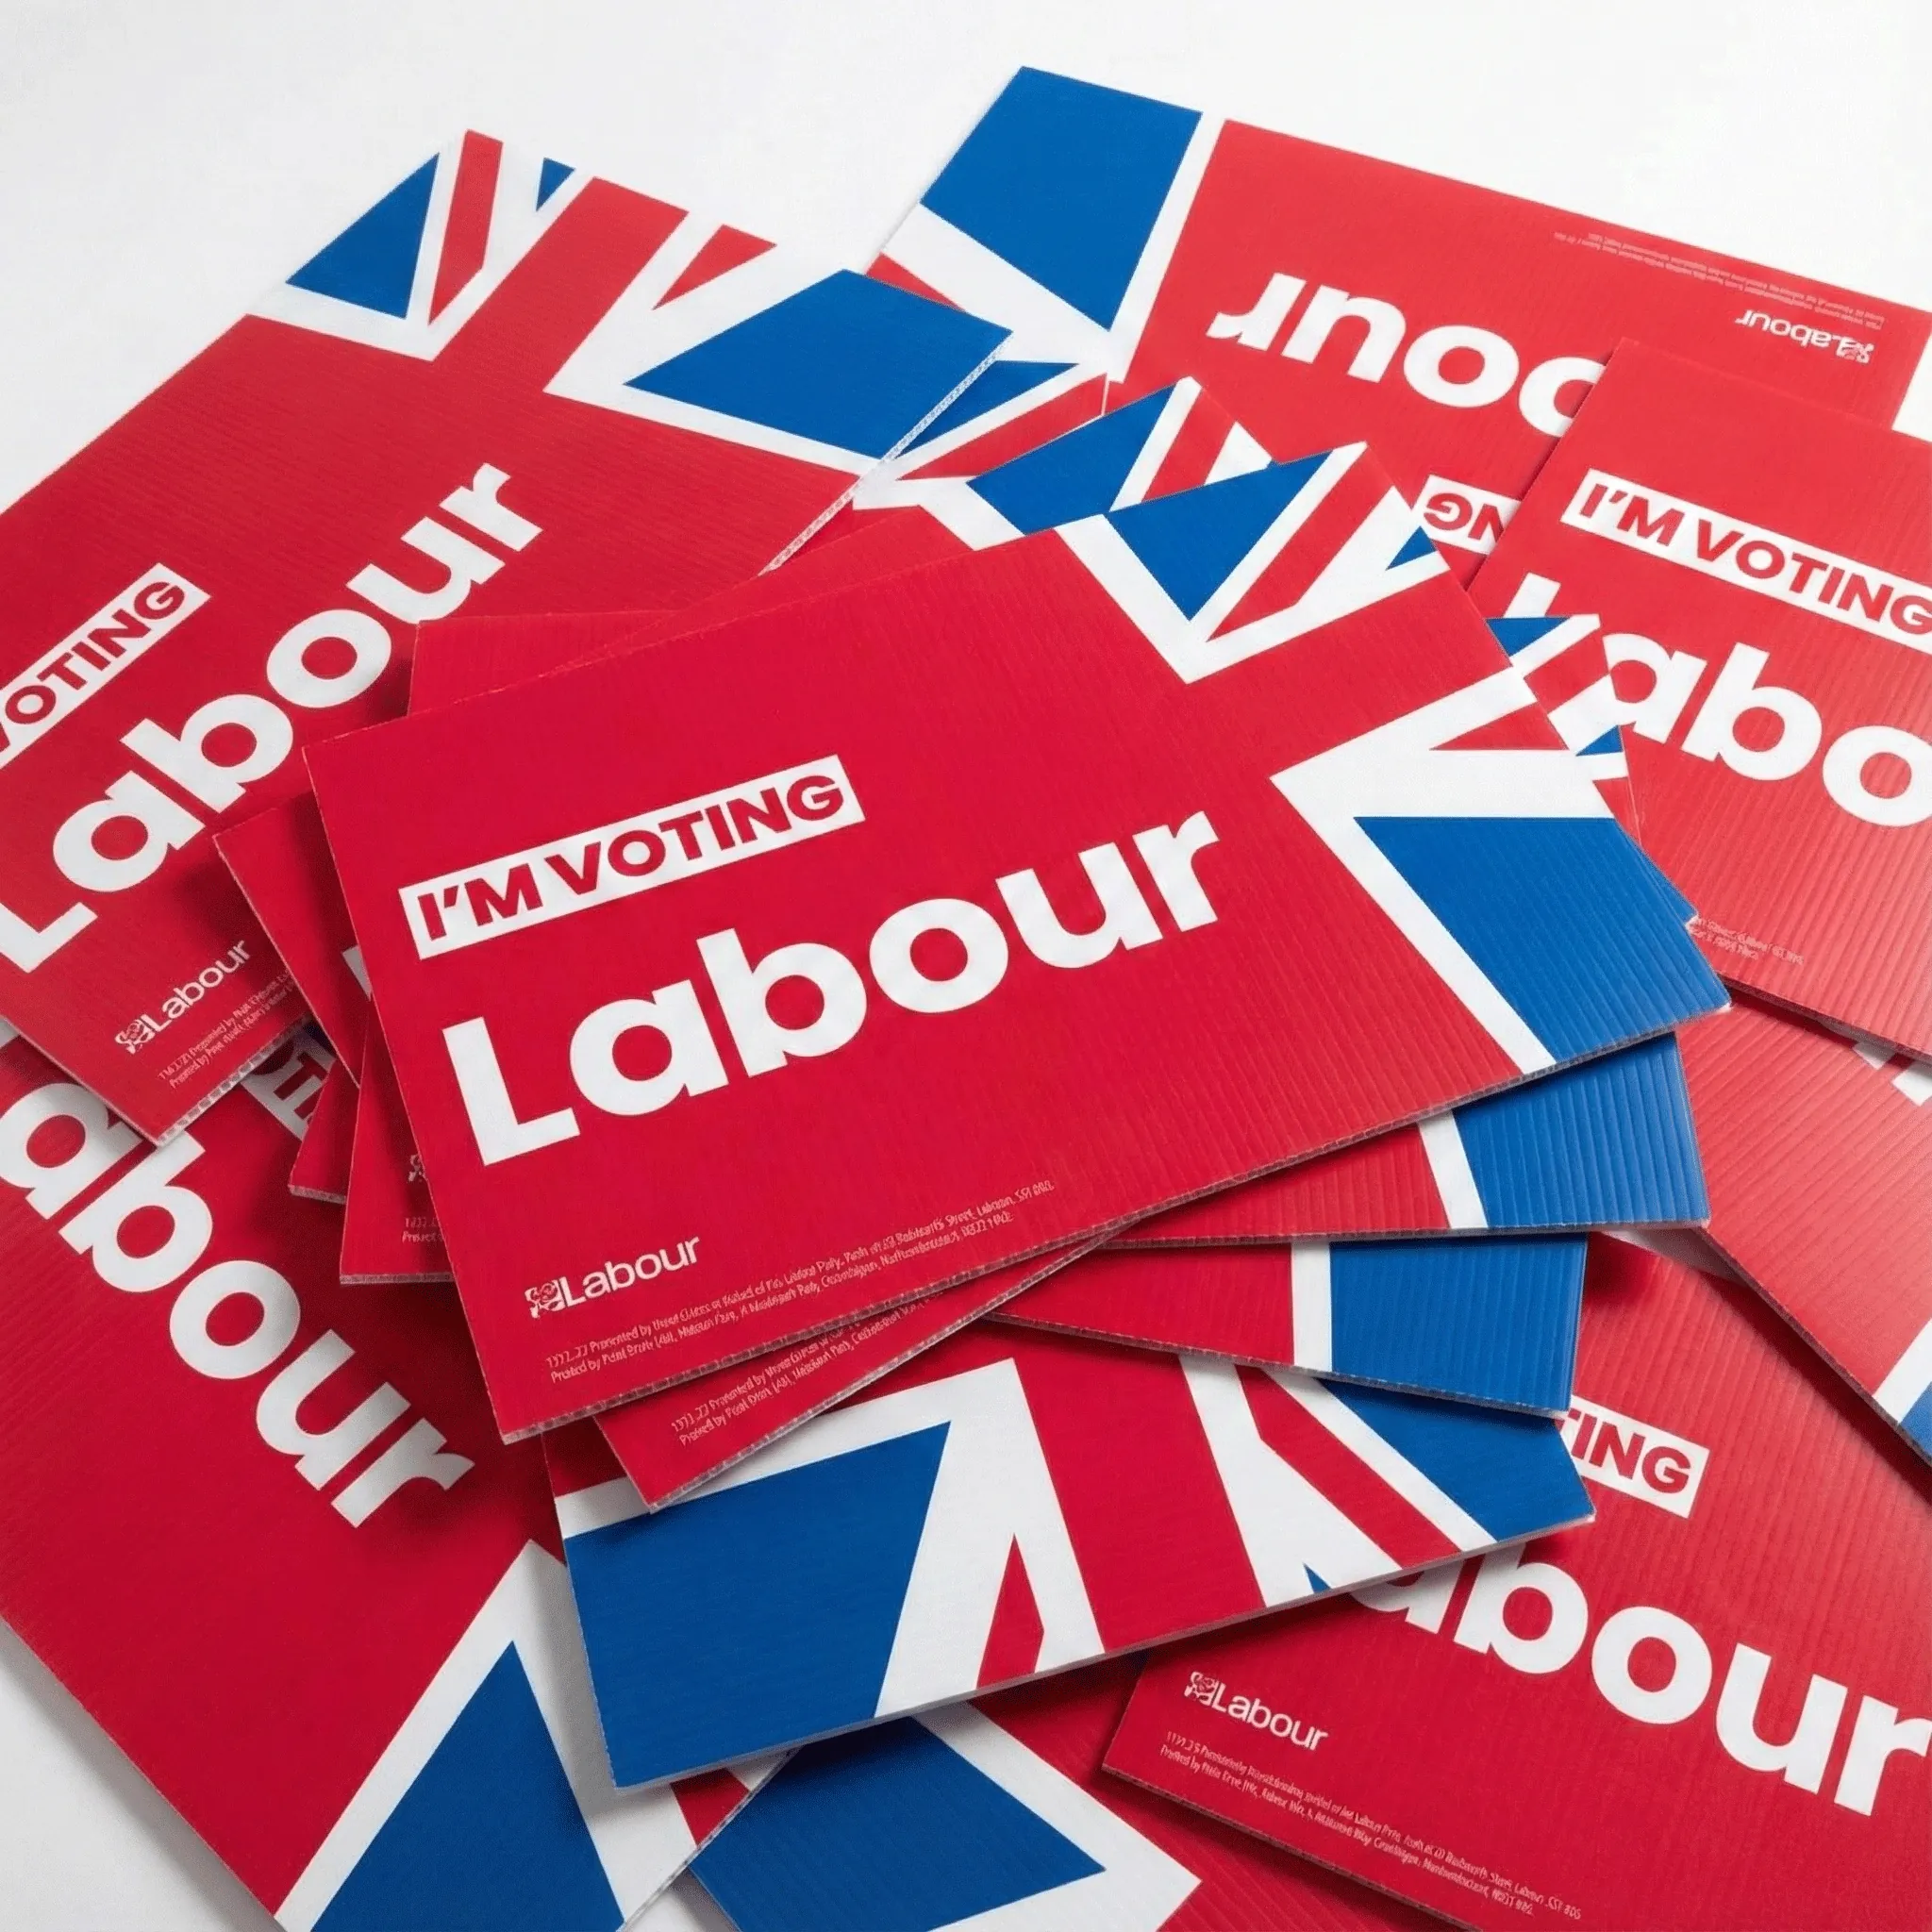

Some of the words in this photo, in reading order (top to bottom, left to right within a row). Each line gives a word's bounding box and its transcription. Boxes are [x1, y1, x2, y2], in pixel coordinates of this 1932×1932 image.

[1734, 309, 1847, 357] Labour
[1697, 518, 1932, 635] VOTING
[0, 581, 186, 753] OTING
[0, 462, 543, 974] Labour
[544, 774, 845, 896] VOTING
[140, 940, 251, 1033] Labour
[442, 810, 1220, 1166] Labour
[559, 1236, 700, 1308] Labour
[1555, 1407, 1691, 1494] ING
[1210, 1682, 1329, 1752] Labour
